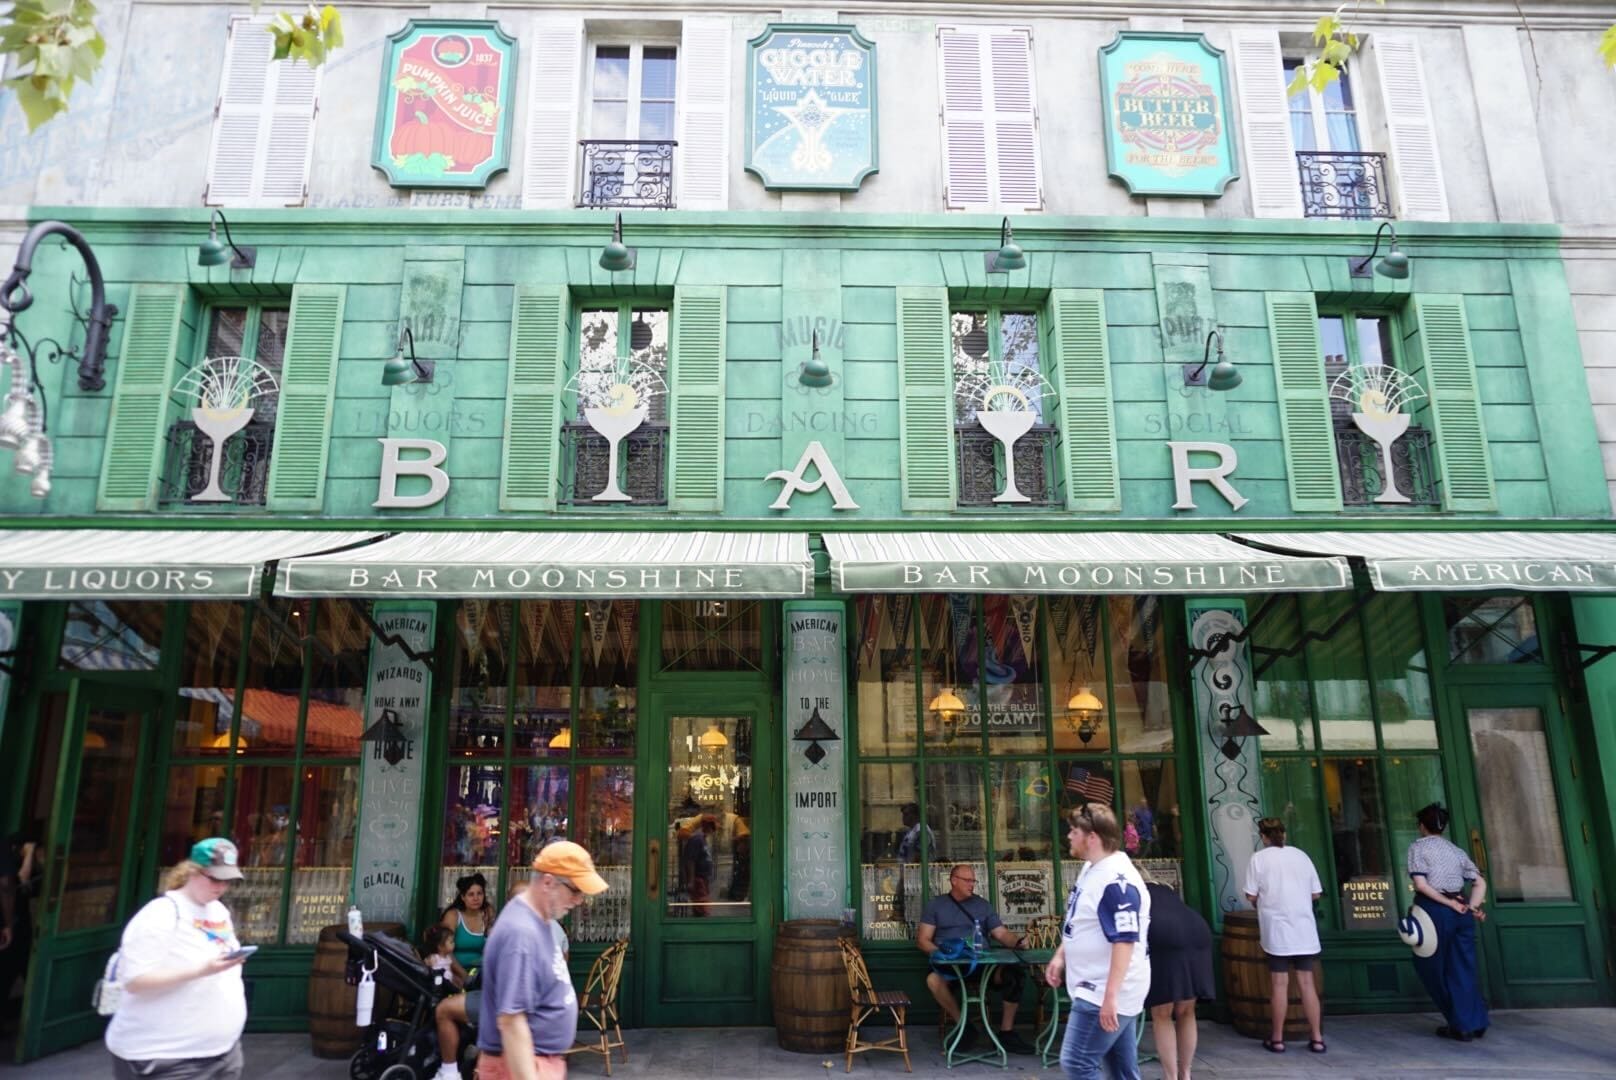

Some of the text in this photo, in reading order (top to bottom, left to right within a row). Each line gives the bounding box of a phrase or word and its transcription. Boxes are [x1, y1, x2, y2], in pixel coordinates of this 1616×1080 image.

[760, 48, 863, 71] GIGGLE
[767, 66, 857, 87] WATER
[402, 63, 494, 127] PUMPKIN JUICE
[1122, 97, 1211, 113] BUTTER
[1140, 112, 1195, 127] BEER
[773, 316, 849, 351] MUSIC
[354, 410, 487, 433] LIQUORS
[747, 411, 878, 433] DANCING
[1144, 412, 1253, 434] SOCIAL
[44, 568, 214, 591] LIQUORS
[348, 568, 744, 589] BAR MOONSHINE
[903, 564, 1286, 586] BAR MOONSHINE
[1408, 563, 1595, 583] AMERICAN
[790, 618, 838, 634] AMERICAN
[376, 667, 422, 684] WIZARDS
[374, 697, 421, 708] HOME AWAY
[800, 697, 829, 709] TO THE
[1011, 703, 1036, 712] BLEU
[971, 712, 1035, 725] OCAMY
[795, 791, 838, 809] IMPORT
[364, 872, 406, 889] GLACIAL
[1343, 882, 1390, 891] PUMPKIN
[295, 895, 344, 904] PUMPKIN
[1352, 892, 1384, 900] JUICE
[301, 905, 337, 914] JUICE
[1113, 911, 1138, 932] 21
